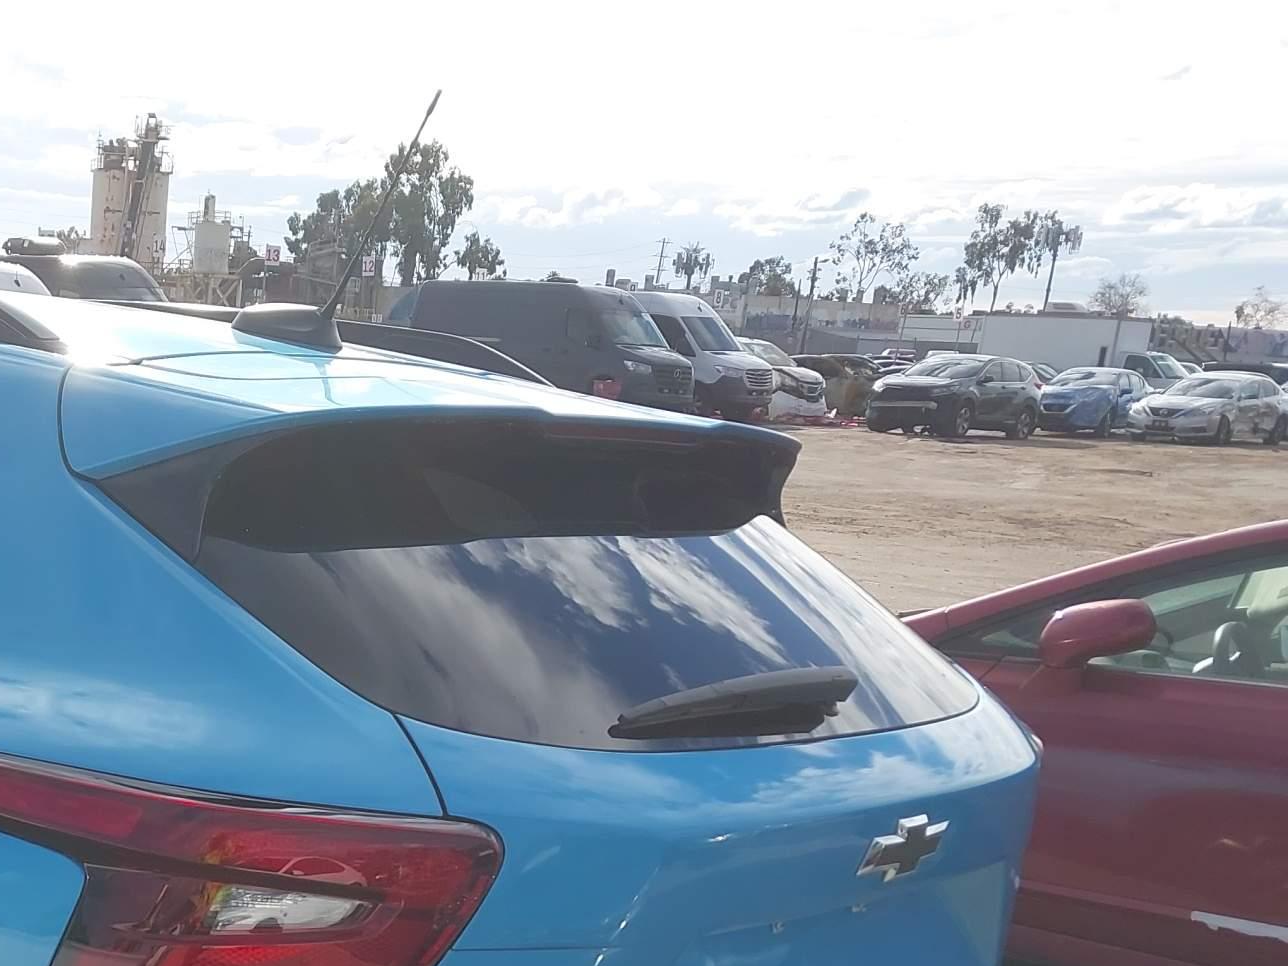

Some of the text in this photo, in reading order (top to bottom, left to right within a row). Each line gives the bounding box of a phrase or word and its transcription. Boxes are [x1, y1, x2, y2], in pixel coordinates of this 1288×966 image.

[154, 240, 166, 253] 14
[265, 248, 281, 262] 13
[363, 260, 375, 272] 12
